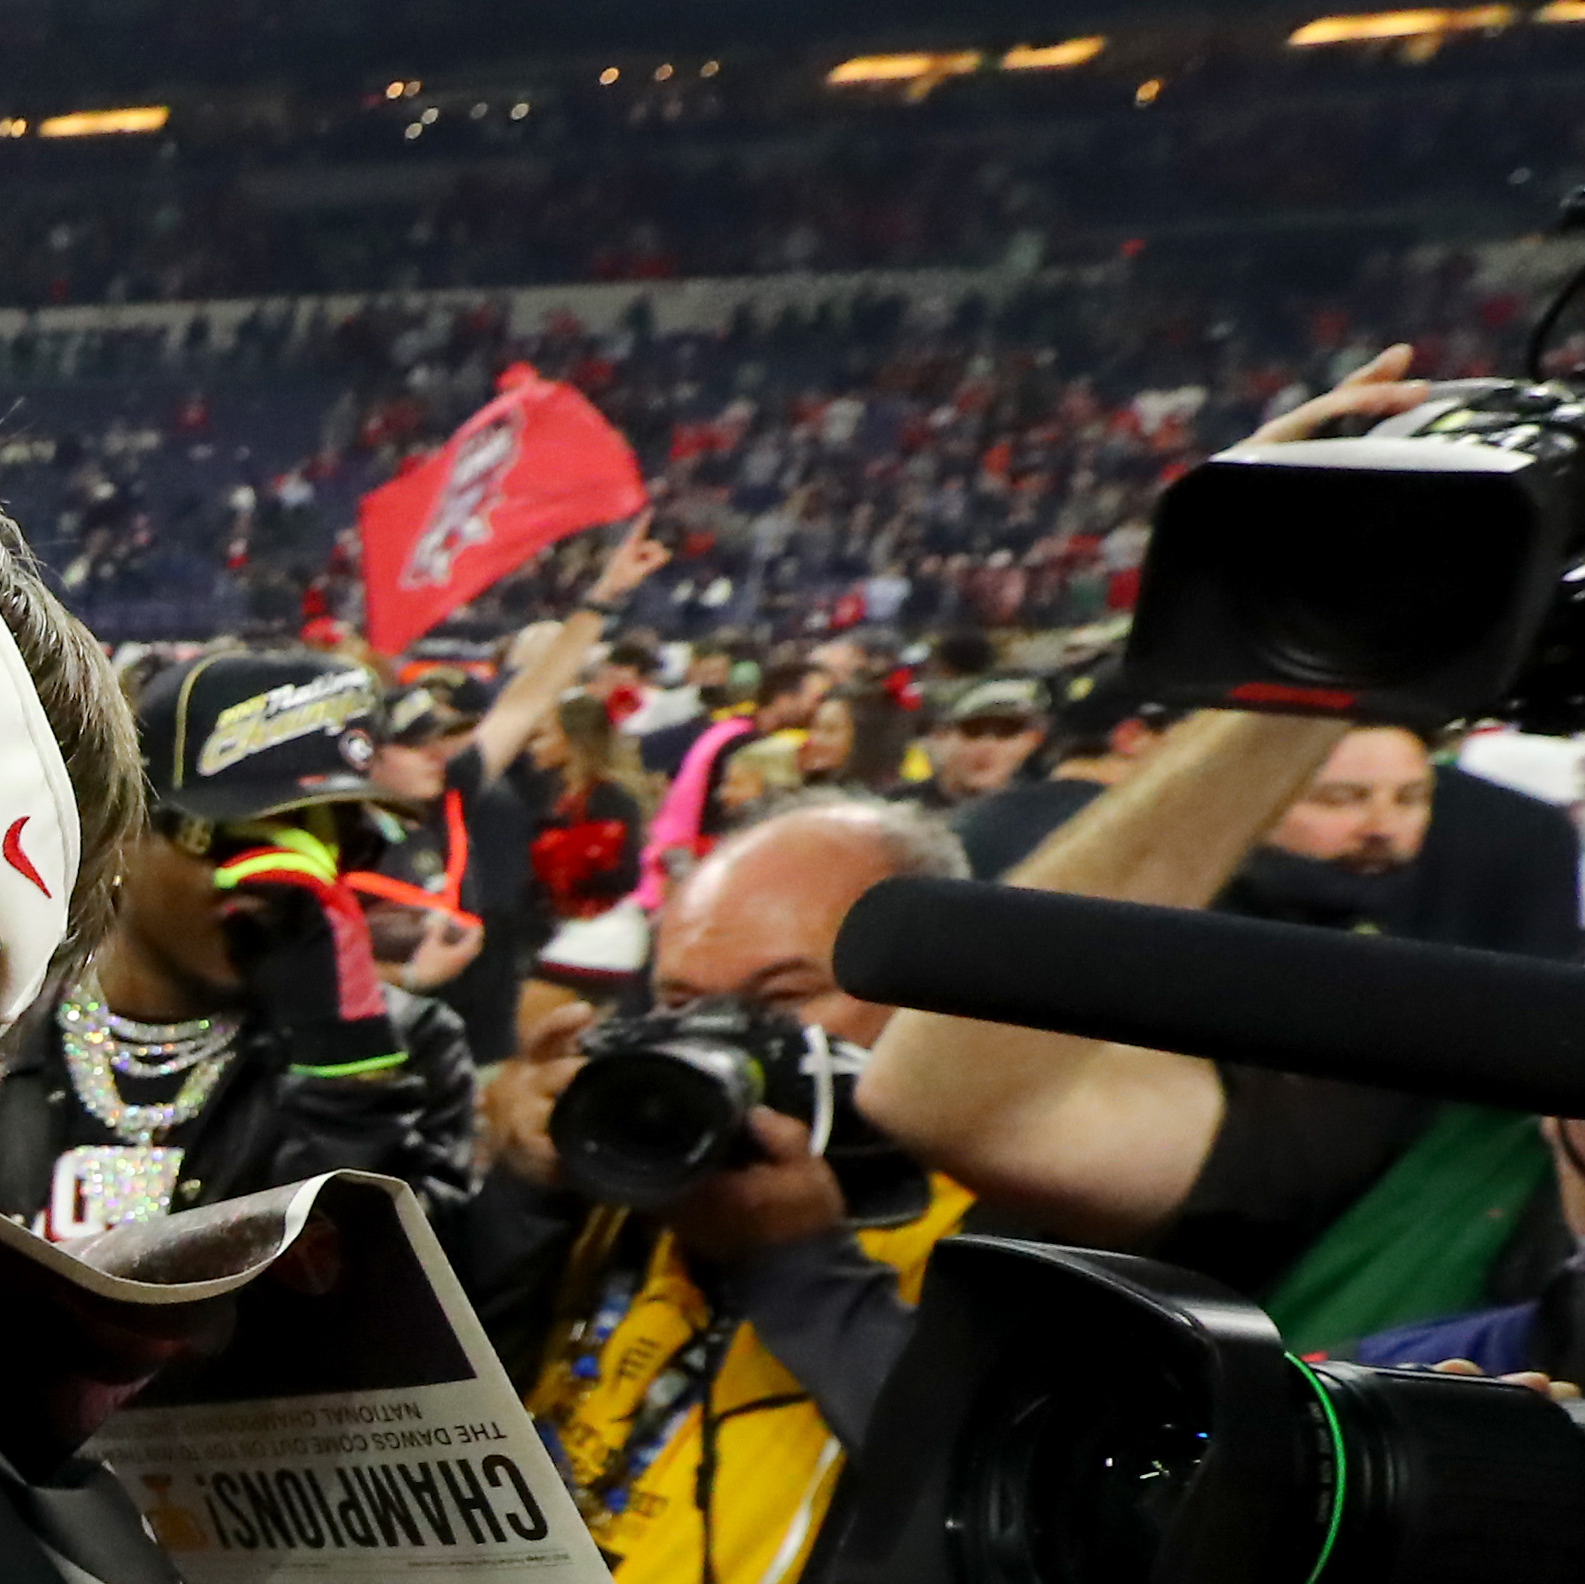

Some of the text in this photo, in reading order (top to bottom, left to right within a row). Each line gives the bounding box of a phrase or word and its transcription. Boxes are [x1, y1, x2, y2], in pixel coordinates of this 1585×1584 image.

[183, 1410, 317, 1436] CHAMPIONSHIP
[325, 1402, 423, 1426] NATIONAL
[312, 1433, 368, 1455] COME
[372, 1427, 447, 1451] DAWGS
[455, 1421, 507, 1445] THE
[180, 1445, 200, 1462] TO
[204, 1443, 237, 1461] TOP
[239, 1440, 267, 1459] ON
[271, 1438, 308, 1457] OUT
[195, 1454, 549, 1550] CHAMPIONS!
